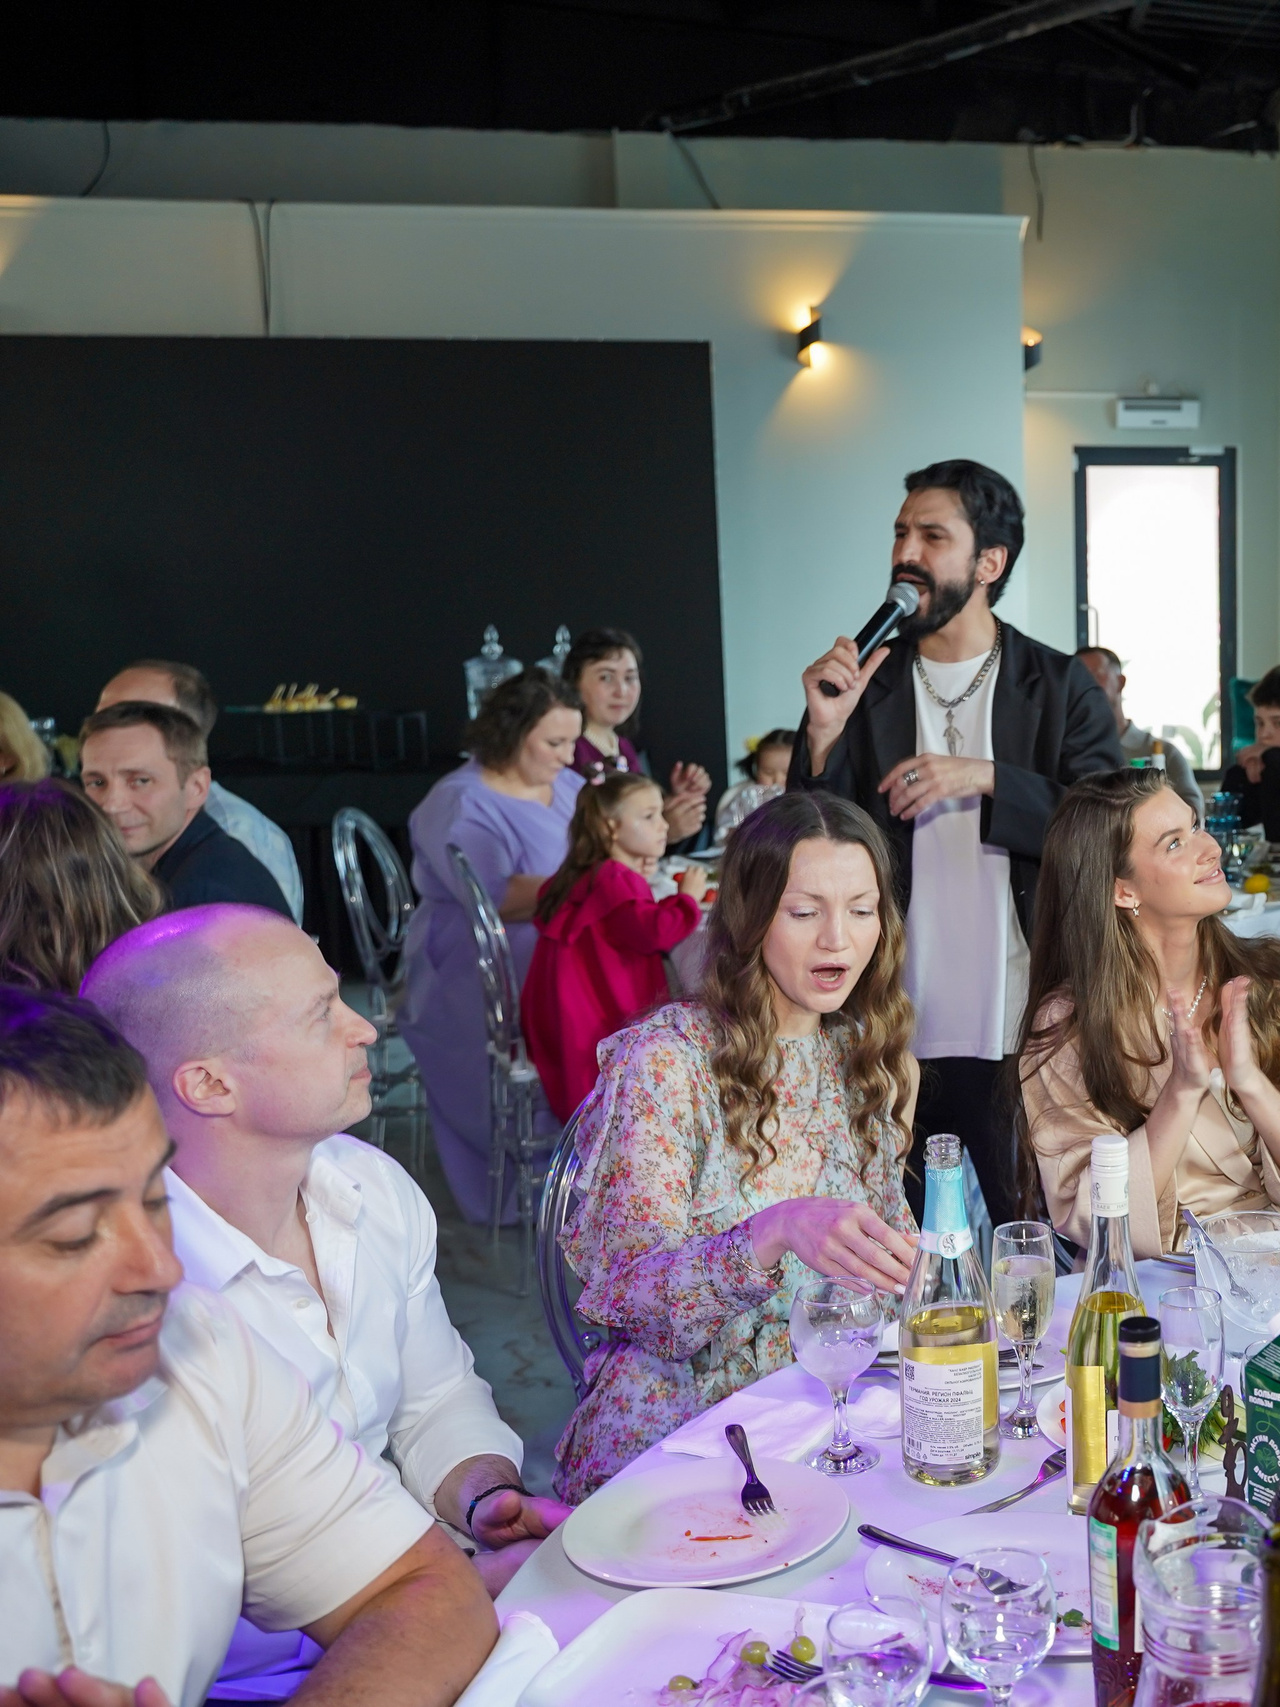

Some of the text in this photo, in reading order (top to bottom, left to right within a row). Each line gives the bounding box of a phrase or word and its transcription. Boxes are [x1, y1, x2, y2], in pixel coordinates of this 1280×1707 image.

[1248, 1395, 1274, 1409] ПОЛЬЗЫ
[1249, 1434, 1269, 1454] РАСТИМ
[964, 1452, 981, 1460] simple
[1253, 1465, 1280, 1483] ВМЕСТЕ
